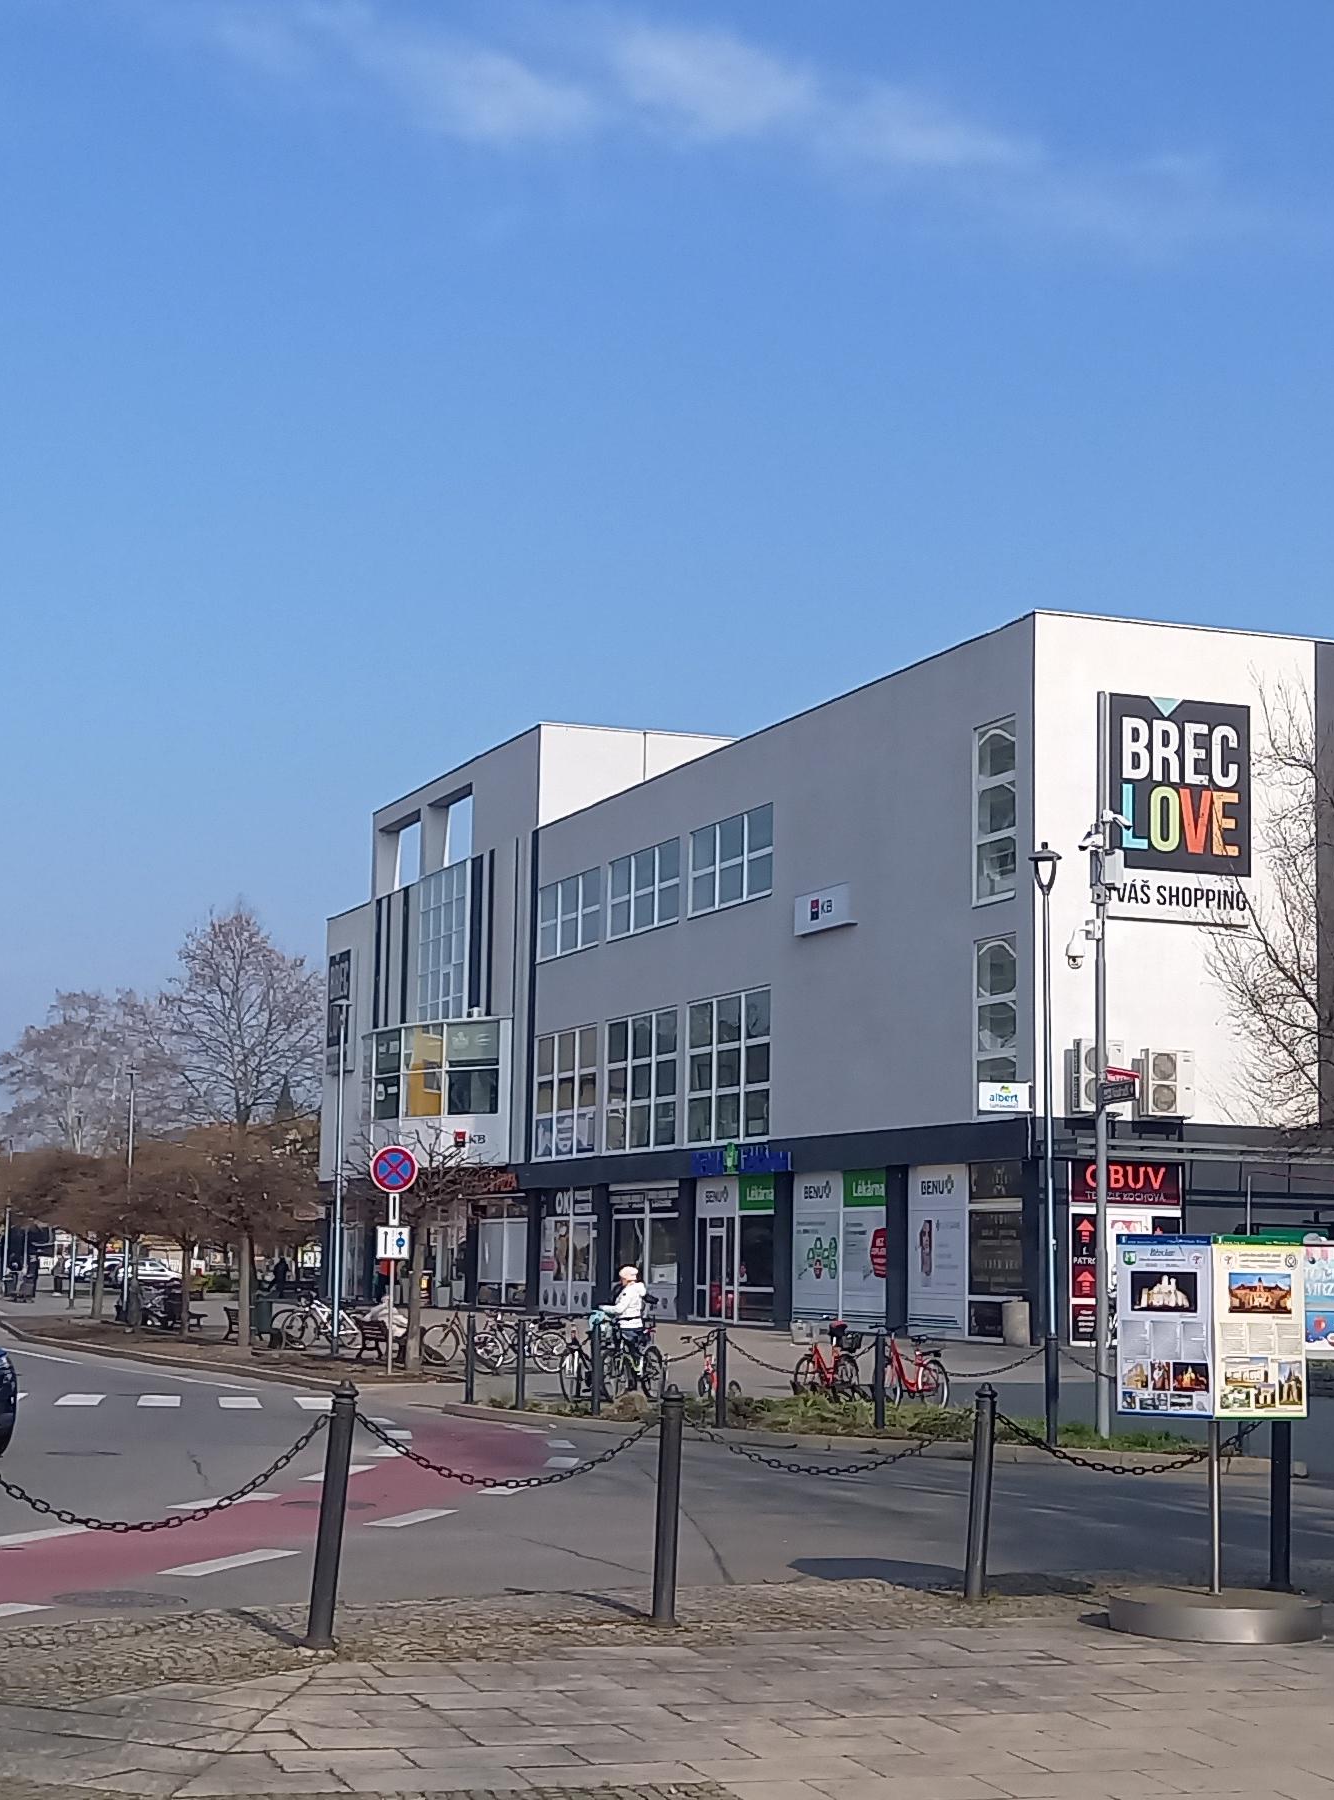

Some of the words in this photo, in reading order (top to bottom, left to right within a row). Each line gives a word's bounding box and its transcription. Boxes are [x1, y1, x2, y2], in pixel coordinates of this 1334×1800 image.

[1122, 716, 1239, 788] BREC
[1122, 783, 1240, 857] LOVE
[1156, 885, 1247, 912] SHOPPING
[804, 1185, 824, 1199] BENU
[921, 1179, 945, 1195] BENU
